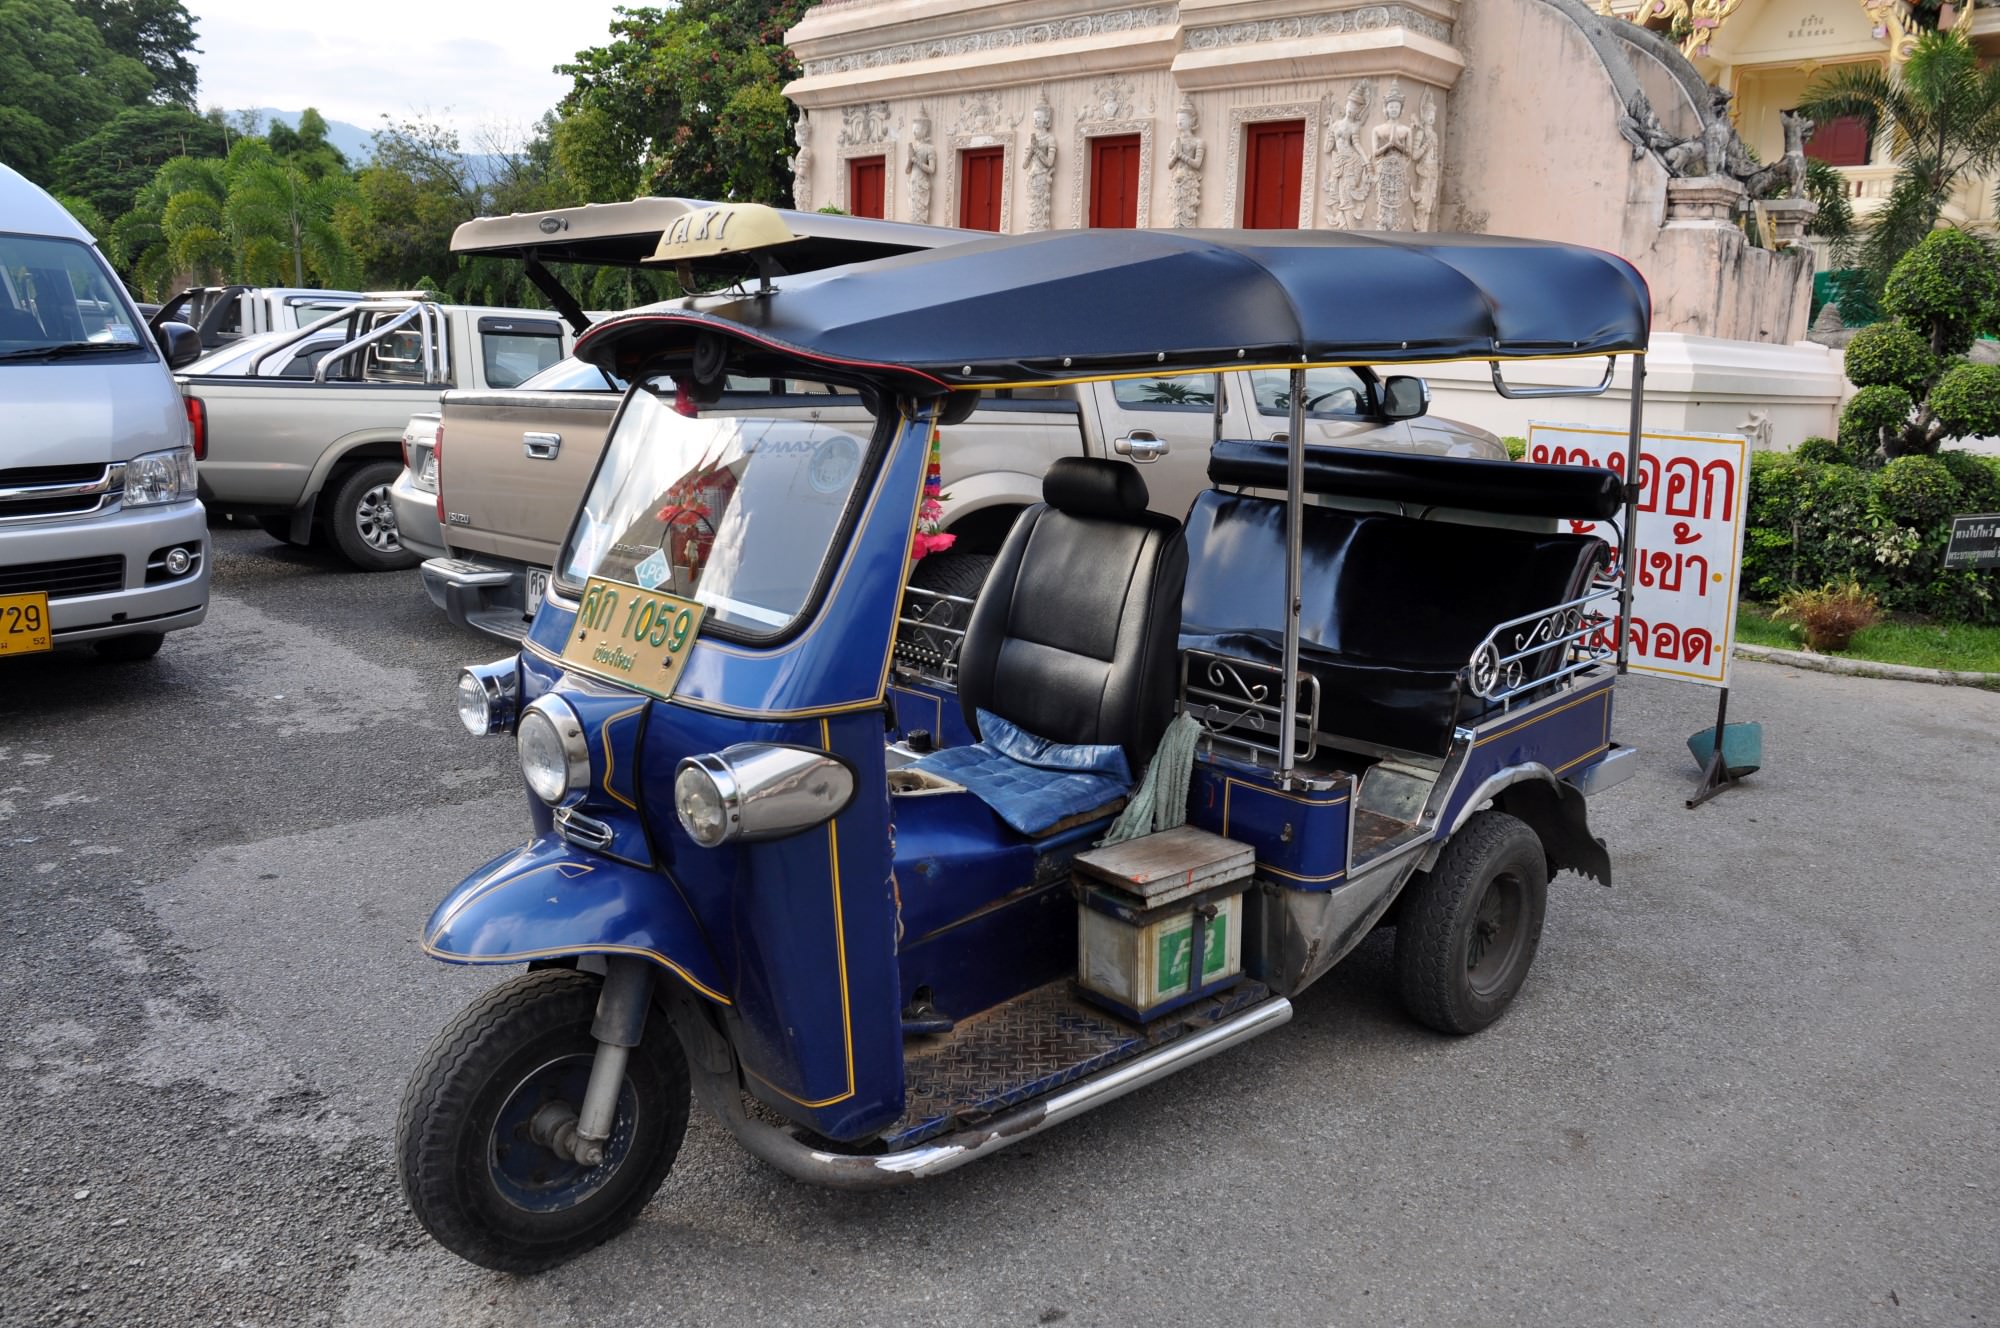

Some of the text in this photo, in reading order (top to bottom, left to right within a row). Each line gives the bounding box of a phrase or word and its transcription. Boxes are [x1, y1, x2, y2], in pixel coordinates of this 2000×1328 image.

[664, 210, 735, 246] TAXI
[1532, 444, 1735, 522] ออก
[448, 511, 471, 524] ISUZU
[640, 562, 664, 582] LPG
[0, 604, 41, 634] 29
[620, 594, 694, 654] 1059
[32, 636, 46, 646] 52
